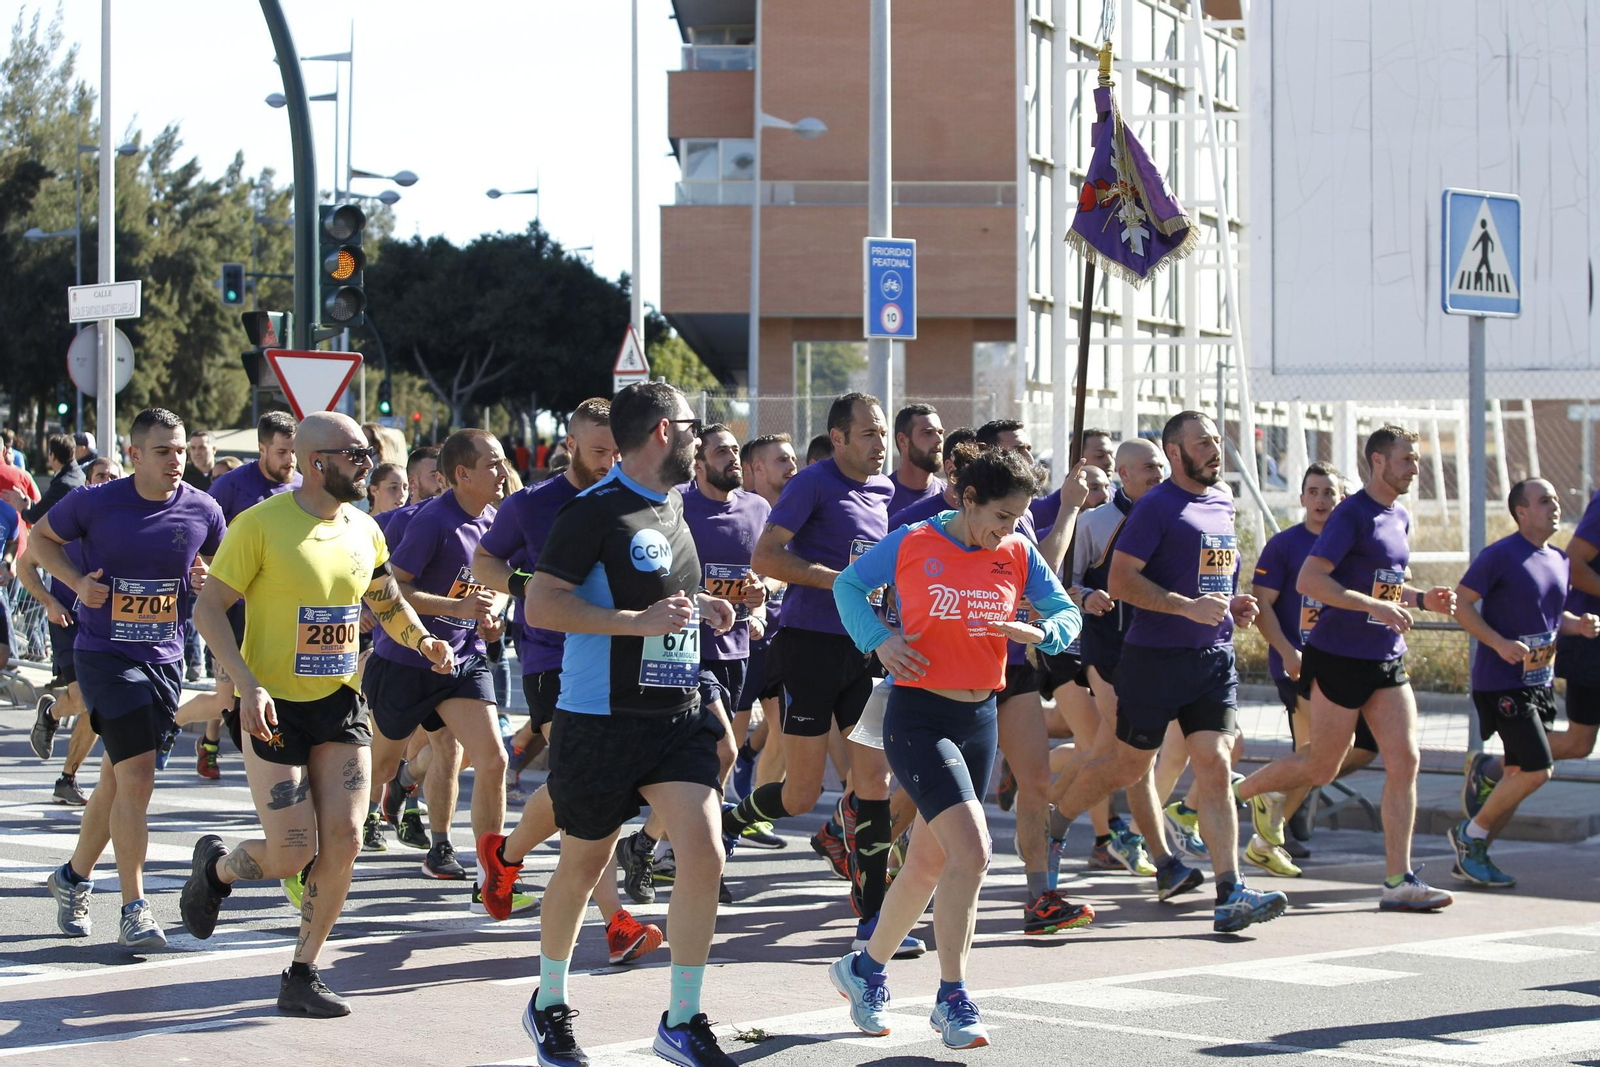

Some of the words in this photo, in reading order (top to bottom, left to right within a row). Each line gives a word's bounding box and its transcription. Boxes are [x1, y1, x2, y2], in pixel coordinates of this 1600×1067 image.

[871, 246, 912, 257] PRIORIDAD
[872, 258, 910, 268] PEATONAL
[94, 290, 112, 299] CALLE
[887, 313, 897, 322] 10
[632, 543, 671, 561] CGM
[1207, 550, 1235, 567] 239
[712, 579, 747, 596] 271
[967, 590, 999, 600] MEDIO
[121, 595, 172, 615] 2704
[967, 600, 1010, 612] MARATÓ
[967, 611, 1007, 621] ALMERÍA
[306, 623, 355, 645] 2800
[663, 629, 697, 652] 671
